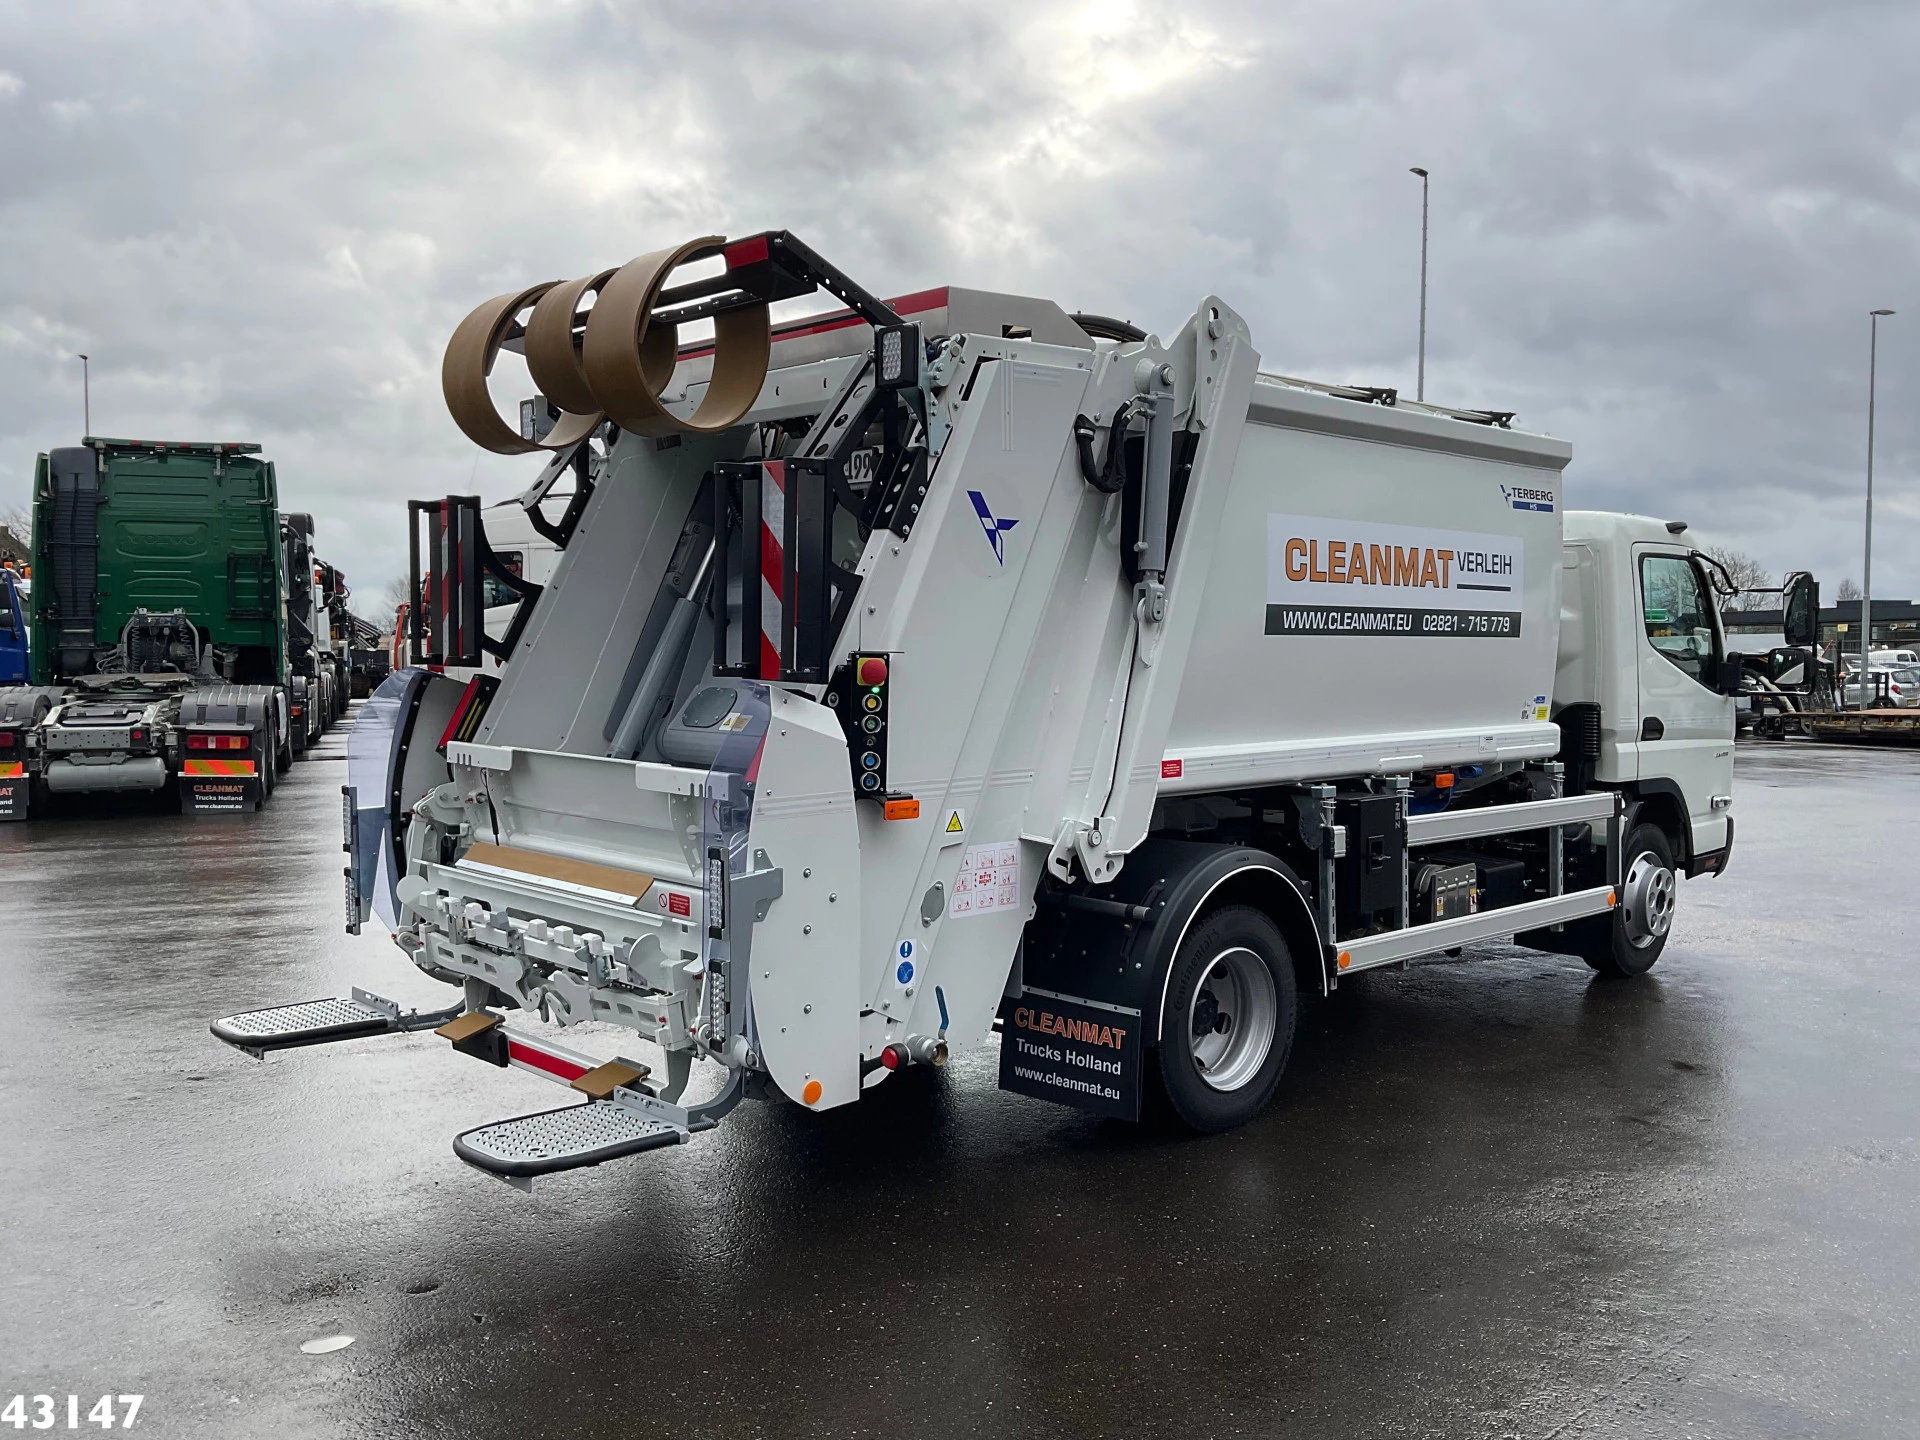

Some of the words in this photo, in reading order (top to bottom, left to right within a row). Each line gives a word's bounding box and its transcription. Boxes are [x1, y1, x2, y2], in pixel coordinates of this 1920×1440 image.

[1511, 487, 1554, 502] TERBERG
[127, 535, 198, 546] VOLVO
[1284, 537, 1454, 589] CLEANMAT
[1457, 550, 1512, 575] VERLEIH
[1283, 611, 1413, 631] WWW.CLEANMAT.EU
[1422, 614, 1458, 632] 02821
[1468, 615, 1488, 632] 715
[1491, 616, 1510, 632] 779
[193, 784, 244, 793] CLEANMAT
[1014, 1006, 1126, 1050] CLEANMAT
[1015, 1037, 1061, 1061] Trucks
[1065, 1049, 1122, 1076] Holland
[1014, 1065, 1120, 1100] www.cleanmat.eu
